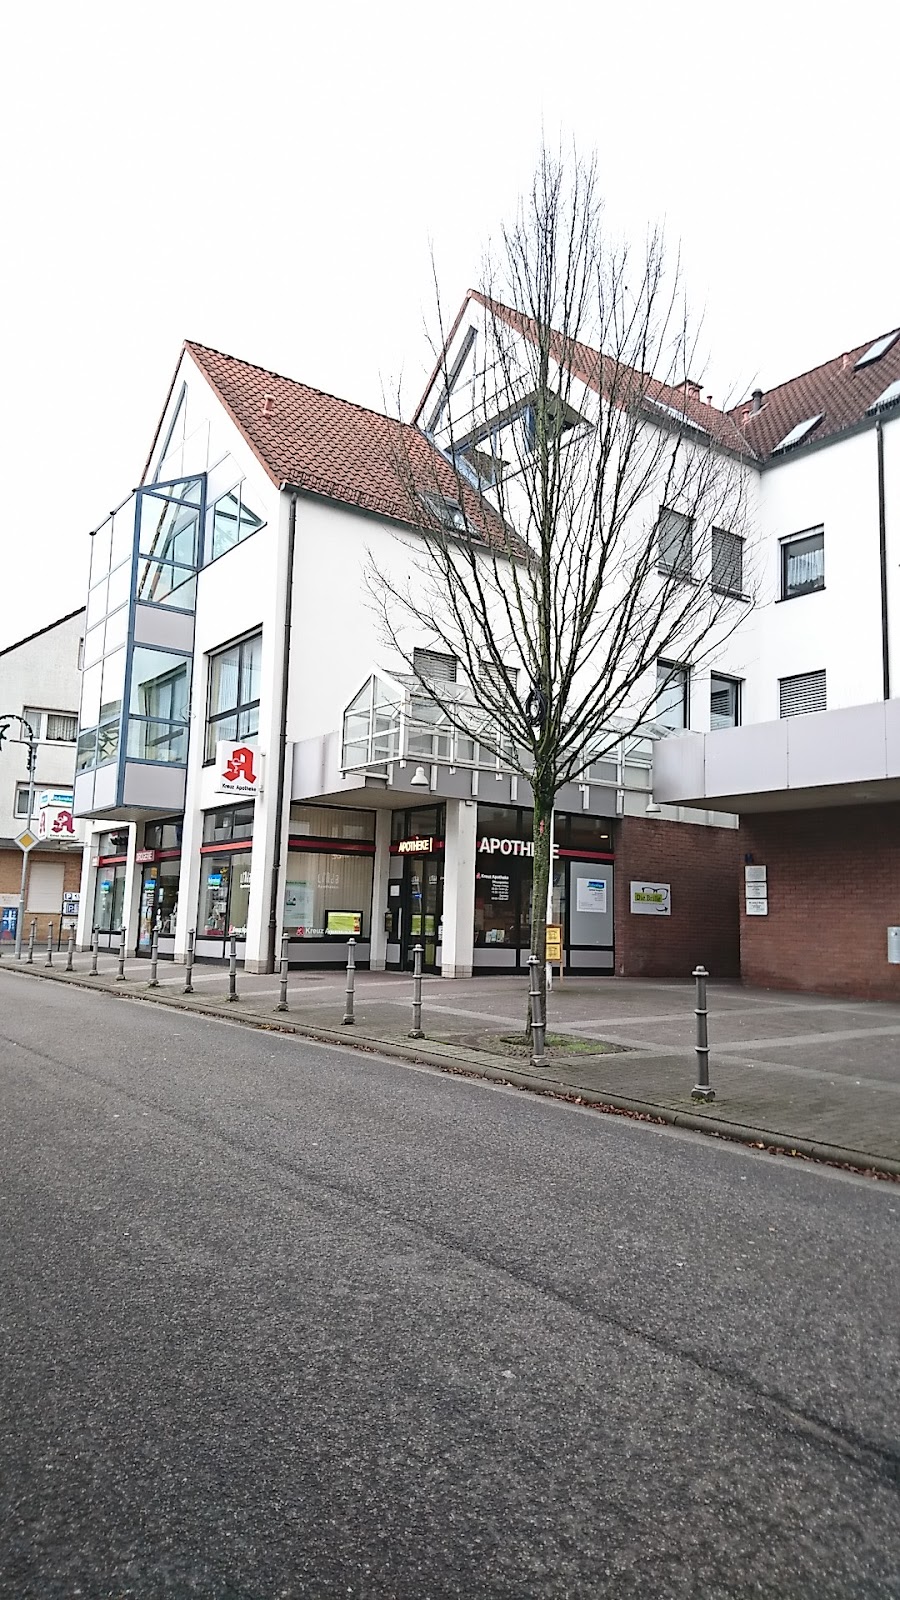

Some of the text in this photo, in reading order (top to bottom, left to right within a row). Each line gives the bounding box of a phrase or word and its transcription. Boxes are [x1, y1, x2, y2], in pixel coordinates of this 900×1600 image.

[398, 839, 430, 853] APOTHEKE
[478, 837, 560, 860] APOTHE
[305, 927, 325, 935] Kreuz
